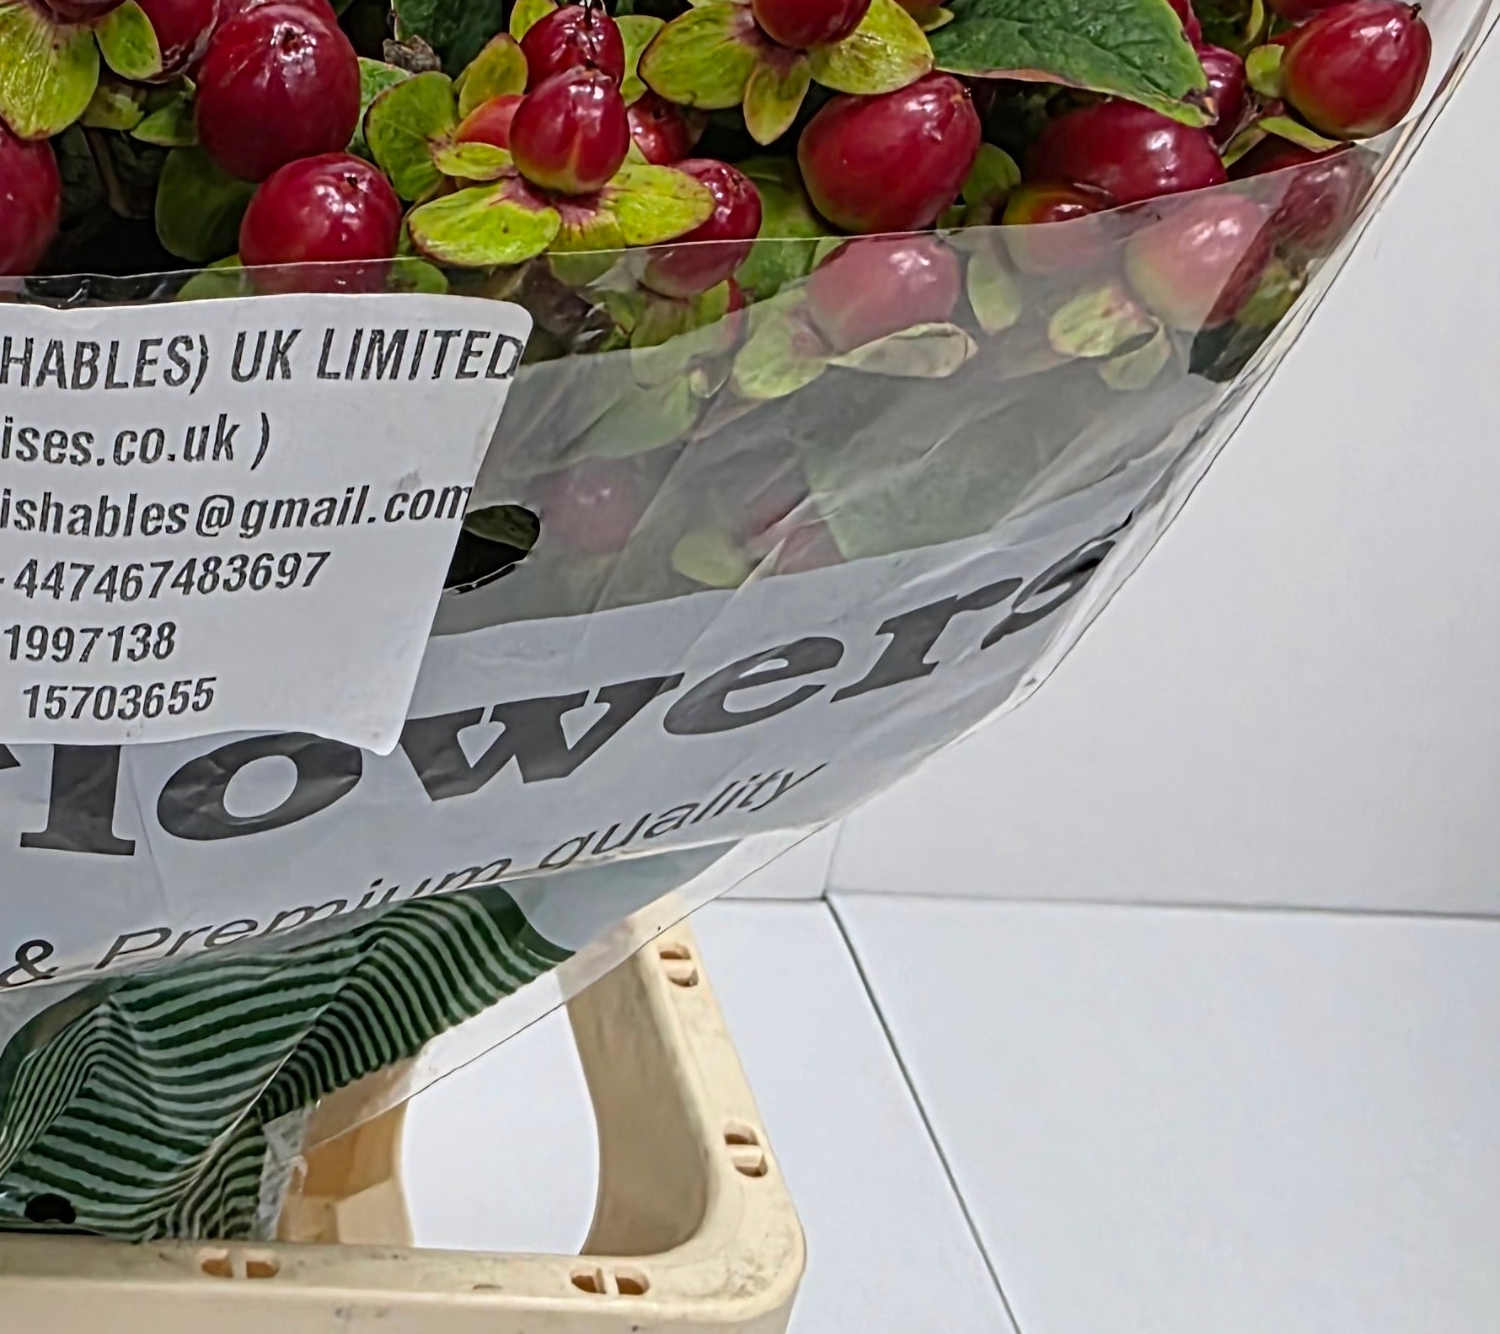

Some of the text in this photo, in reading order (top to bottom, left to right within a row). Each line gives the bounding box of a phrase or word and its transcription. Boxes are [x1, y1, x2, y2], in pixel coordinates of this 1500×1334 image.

[231, 328, 302, 384] UK
[316, 327, 524, 381] LIMITED
[22, 677, 217, 721] 15703655
